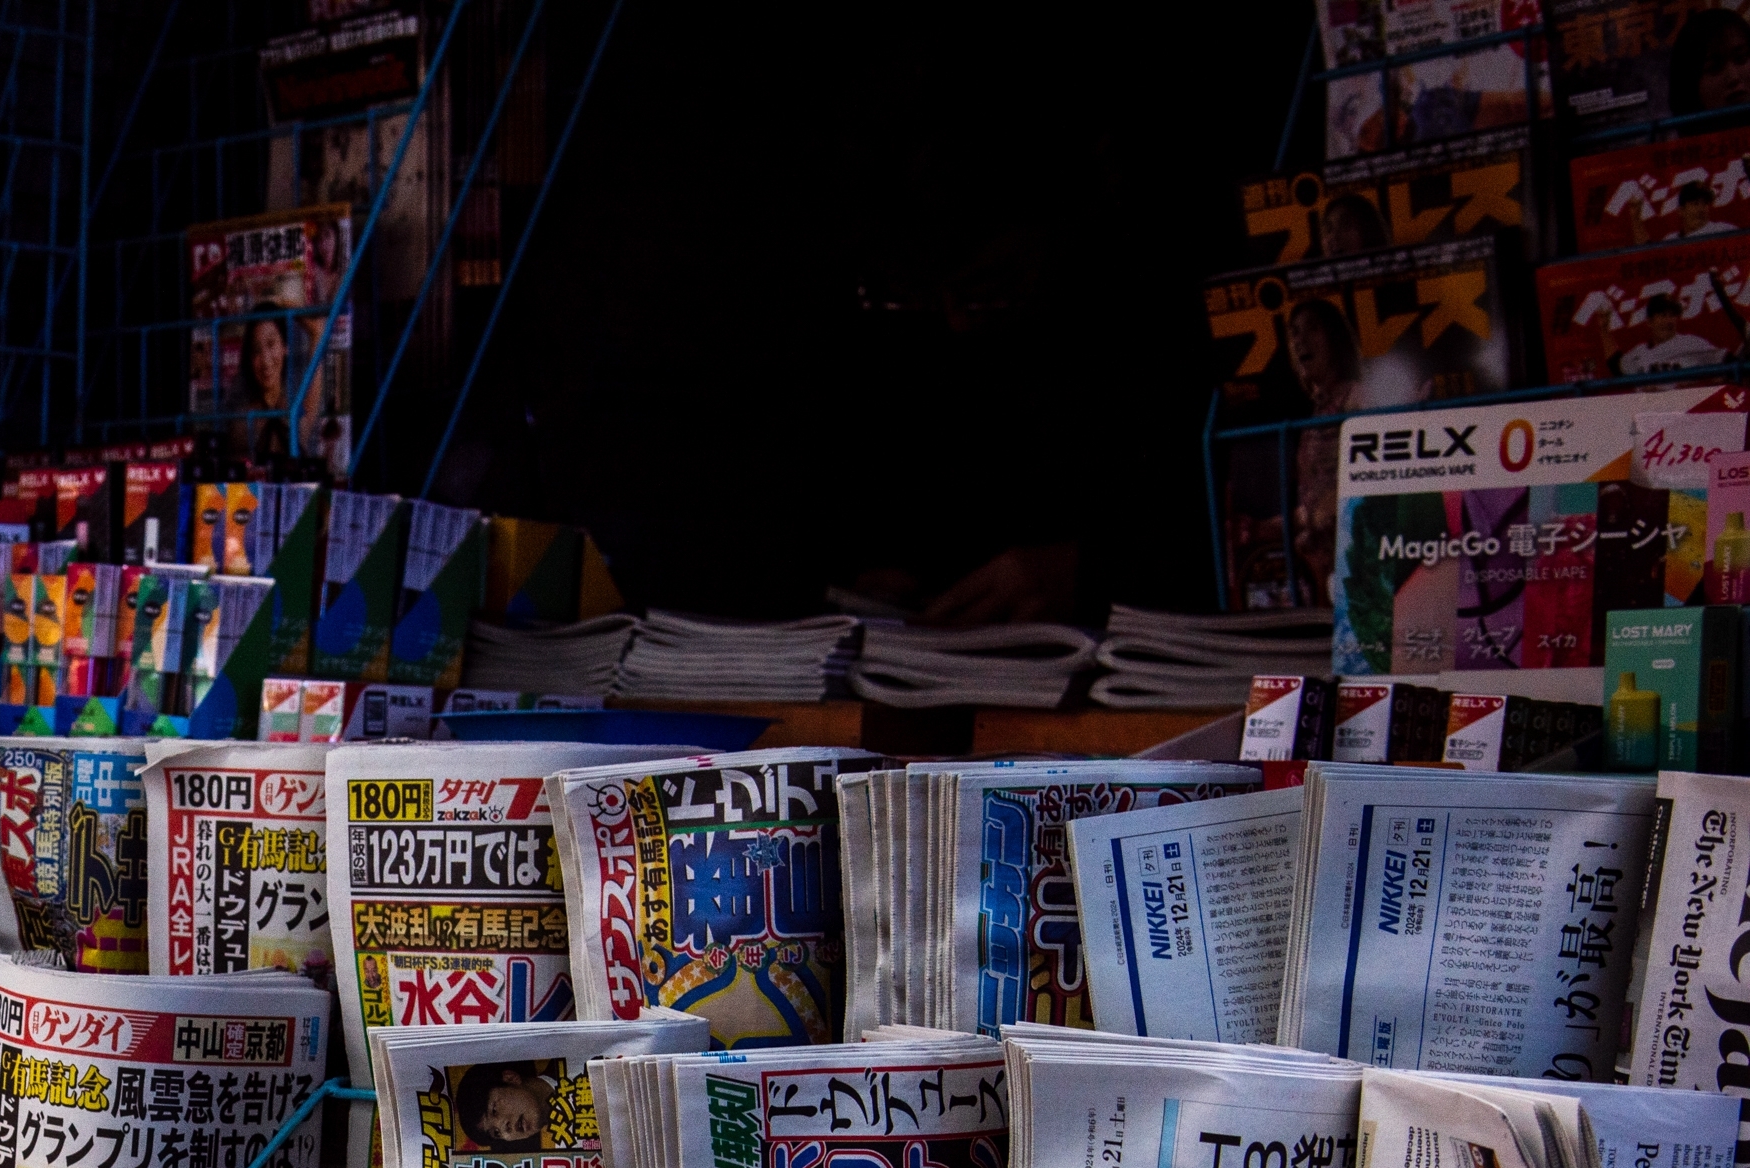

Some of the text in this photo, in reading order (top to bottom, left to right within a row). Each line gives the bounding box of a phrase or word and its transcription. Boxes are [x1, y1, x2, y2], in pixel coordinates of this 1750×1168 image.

[1350, 425, 1478, 463] RELX
[1499, 418, 1534, 473] 0
[1538, 419, 1575, 431] ニコチン
[1538, 436, 1565, 448] タール
[1349, 463, 1477, 482] WORLD'S LEADING VAPE
[1379, 520, 1690, 566] MagicGo 電子シーシャ
[1463, 565, 1588, 584] DISPOSABLE VAPE
[1462, 627, 1517, 643] グレープ
[1535, 633, 1578, 649] スイカ
[1611, 622, 1694, 640] LOST MARY
[1253, 679, 1285, 690] RELX
[1340, 688, 1373, 698] RELX
[1452, 698, 1486, 709] RELX
[76, 751, 94, 806] 日曜
[173, 773, 252, 811] 180円
[263, 782, 275, 806] 日刊
[438, 777, 497, 805] 夕刊
[351, 783, 422, 820] 180円
[437, 806, 488, 822] zakzak
[0, 764, 42, 899] 東スポ
[36, 761, 64, 897] 競馬特別版
[351, 829, 367, 884] 年収の壁
[368, 829, 542, 887] 123万円では
[638, 780, 670, 945] あす有馬記念
[1408, 817, 1435, 900] 12月21日 土
[1720, 812, 1736, 896] INCORPORATING
[170, 813, 192, 974] JRA全レ
[1164, 842, 1187, 925] 12月21日 土
[1378, 849, 1408, 936] NIKKEI
[359, 905, 568, 950] 大波乱!?有馬記念
[595, 823, 644, 1020] サンスポ
[981, 792, 1031, 1038] ニッカン
[1148, 880, 1173, 961] NIKKEI
[1405, 902, 1416, 935] 2024年
[1668, 809, 1728, 1021] The New York
[1176, 926, 1186, 959] 2024年
[398, 969, 500, 1026] 水谷
[41, 1006, 129, 1051] ゲンダイ
[175, 1021, 289, 1061] 中山 確定 京都
[1650, 991, 1667, 1070] INTERNATIONAL
[10, 1054, 111, 1111] 有馬記念
[768, 1065, 1005, 1135] ドウデュース
